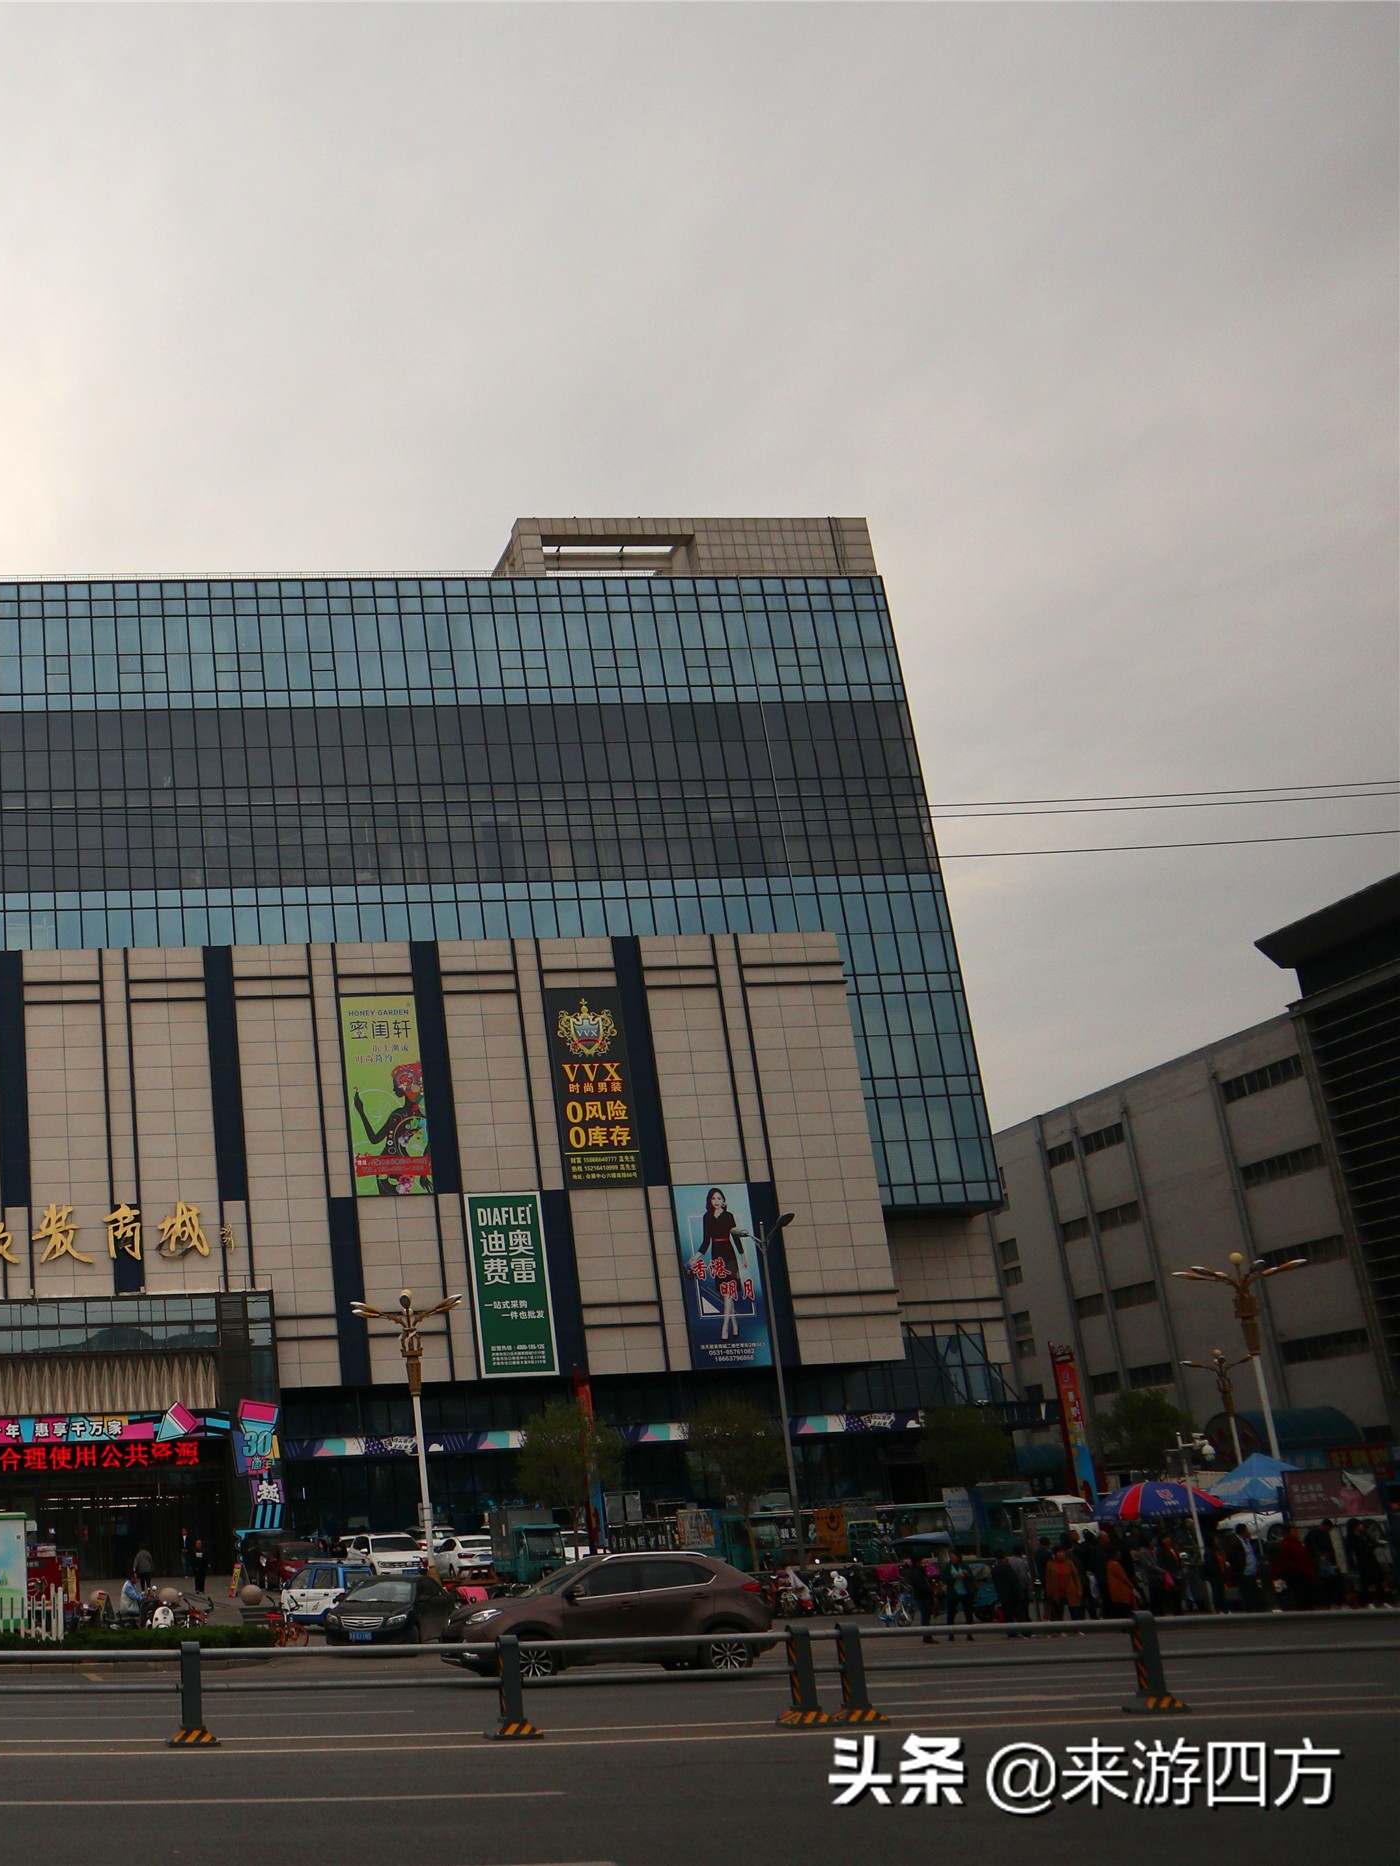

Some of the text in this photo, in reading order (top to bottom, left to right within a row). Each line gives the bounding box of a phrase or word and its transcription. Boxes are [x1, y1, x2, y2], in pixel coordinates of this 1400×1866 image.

[576, 1029, 598, 1037] VVX
[561, 1062, 623, 1082] VVX
[568, 1081, 623, 1094] 时尚男装
[566, 1100, 629, 1123] 0风险
[569, 1125, 632, 1149] 0库存
[477, 1206, 532, 1226] DIAFLEI
[480, 1230, 535, 1257] 迪奥
[483, 1257, 537, 1286] 费雷
[691, 1257, 732, 1280] 香港
[720, 1278, 756, 1301] 明月
[484, 1300, 528, 1310] 一站式采购
[501, 1310, 545, 1320] 一件也批发
[34, 1420, 124, 1438] 惠享千万家
[242, 1430, 273, 1457] 30
